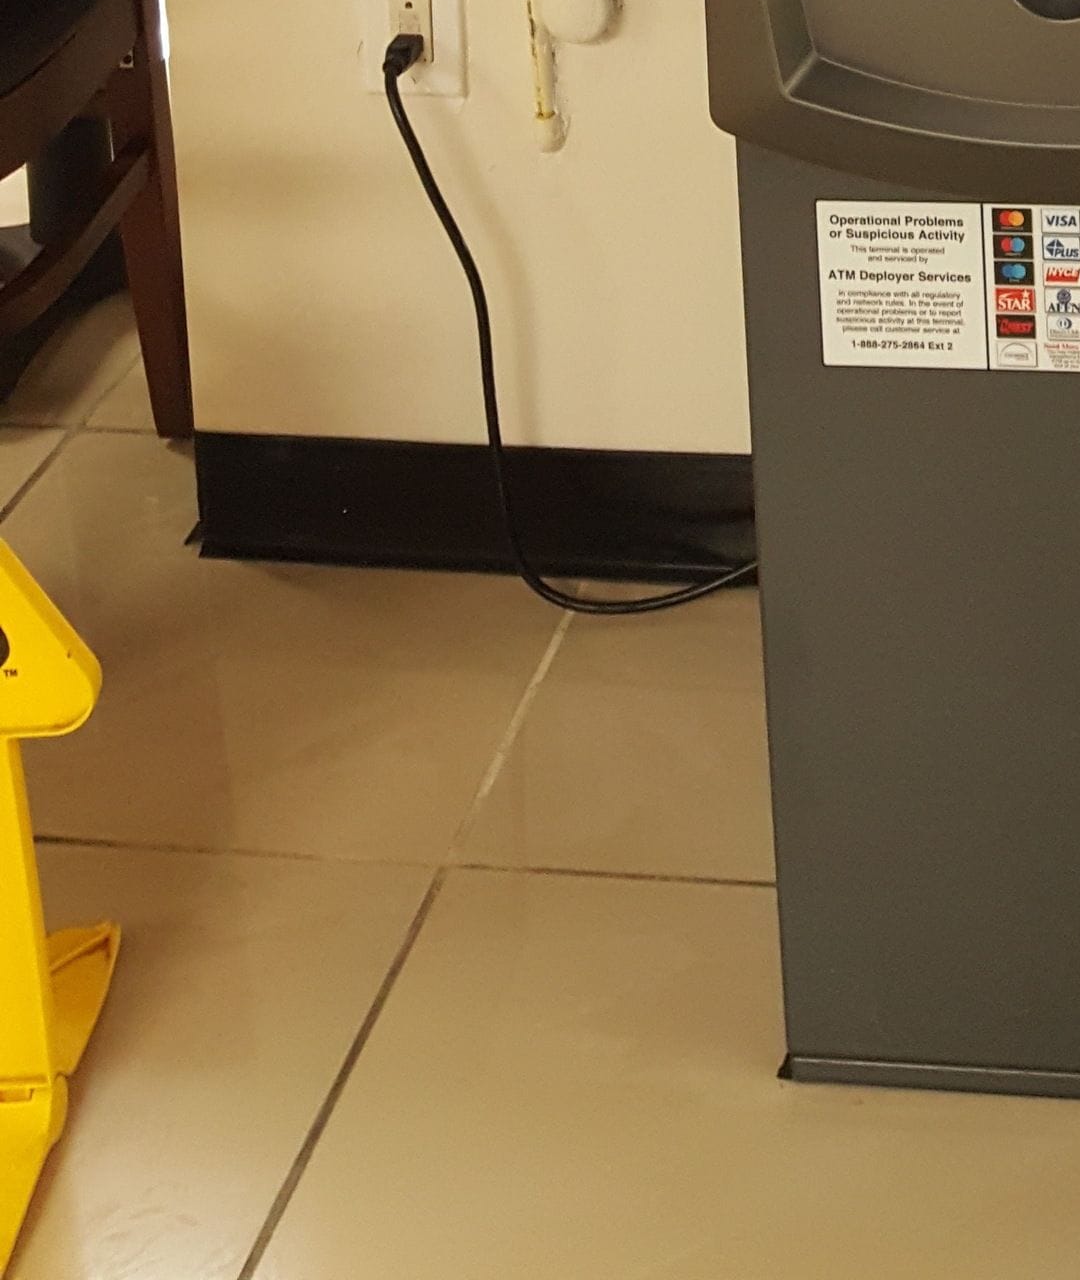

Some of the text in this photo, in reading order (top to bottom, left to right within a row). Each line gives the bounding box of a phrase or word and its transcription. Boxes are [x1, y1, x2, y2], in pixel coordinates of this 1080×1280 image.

[830, 215, 963, 227] Operational Problems
[1046, 216, 1077, 227] VISA
[830, 229, 965, 243] or Suspicious Activity
[851, 245, 867, 253] This
[911, 247, 945, 255] operated
[1055, 248, 1079, 258] PLUS
[919, 256, 928, 264] by
[829, 270, 971, 283] ATM Deployer Services
[1049, 267, 1080, 277] NYCE
[847, 290, 890, 299] compliance
[922, 291, 960, 300] regulatory
[999, 299, 1031, 311] STAR
[837, 308, 879, 316] operational
[882, 308, 917, 317] problems
[939, 310, 961, 318] report
[878, 317, 904, 325] activity
[870, 325, 883, 333] call
[928, 341, 944, 350] Ext
[947, 341, 953, 351] 2
[3, 669, 18, 678] TM
